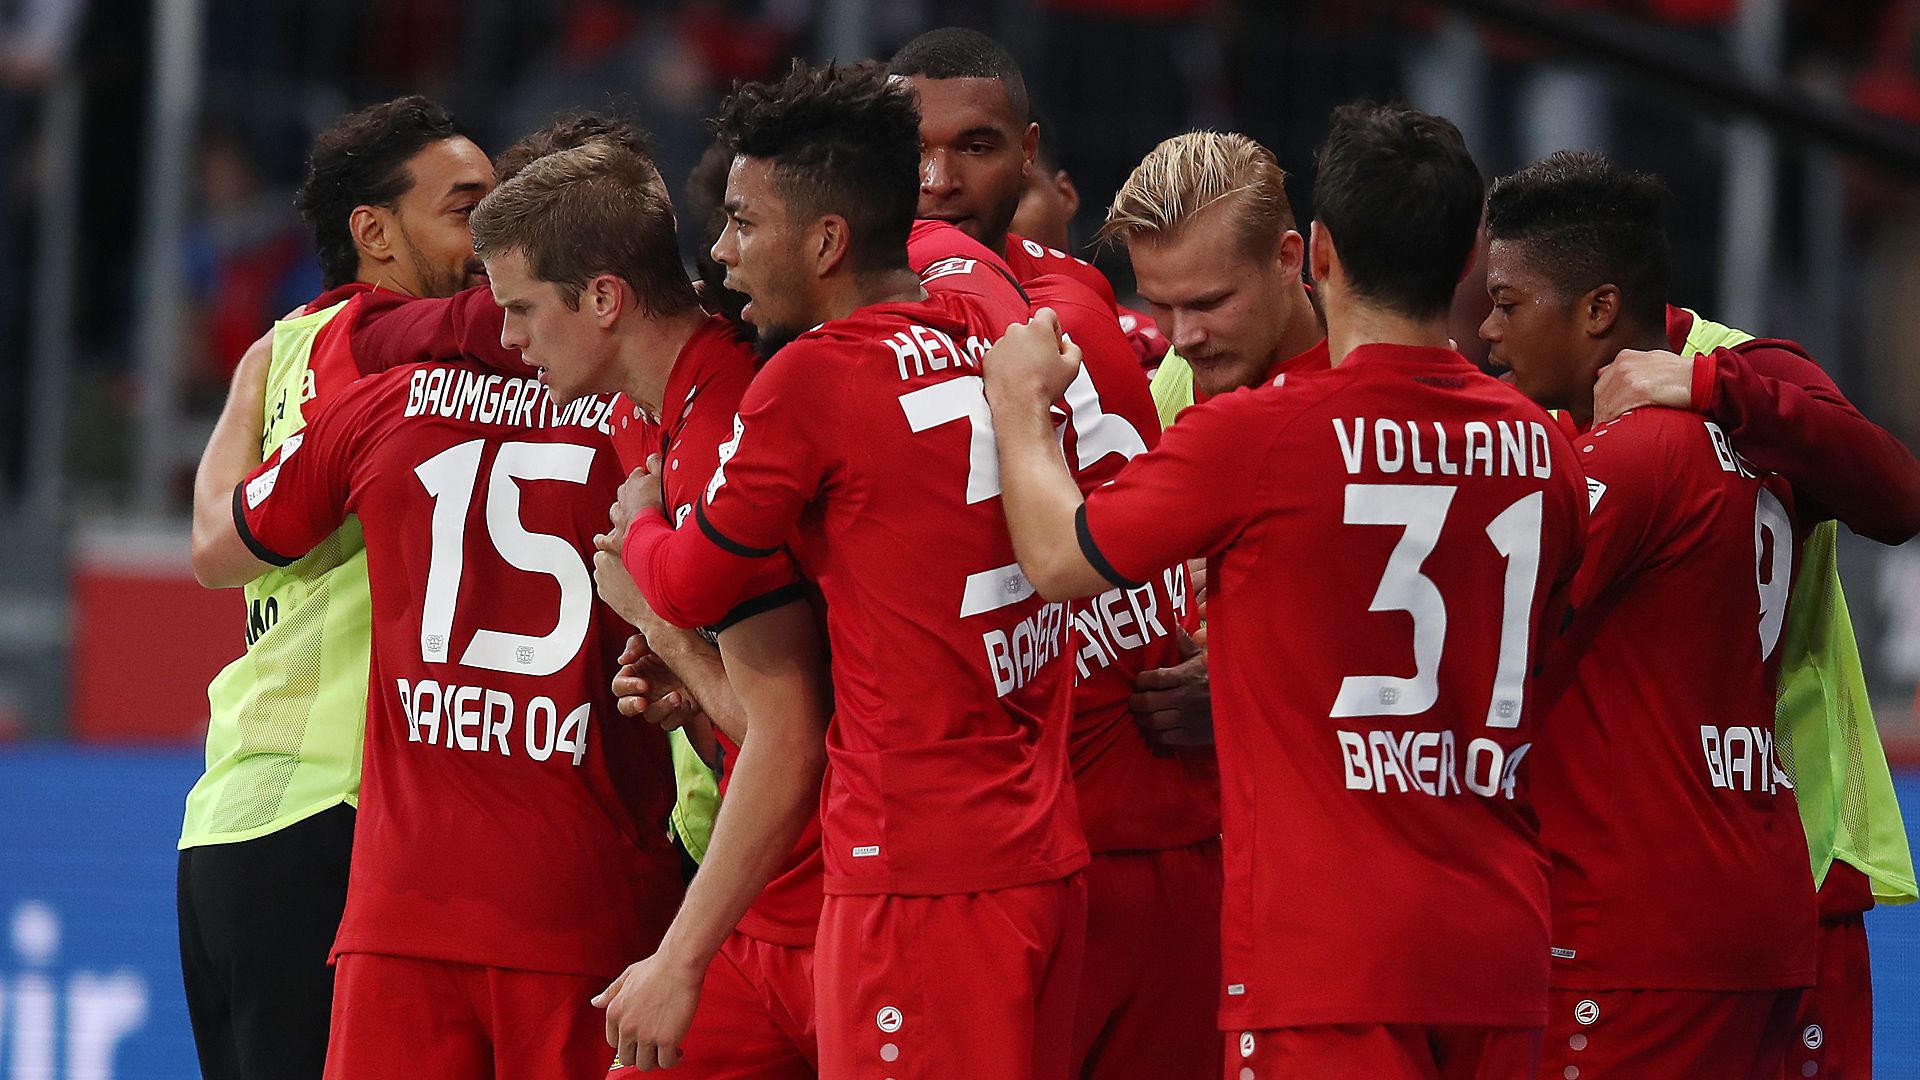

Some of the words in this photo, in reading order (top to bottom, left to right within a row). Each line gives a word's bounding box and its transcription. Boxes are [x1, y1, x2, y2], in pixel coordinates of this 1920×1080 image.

[1332, 417, 1551, 479] VOLLAND
[413, 439, 597, 676] 15
[1329, 484, 1544, 728] 31
[1754, 486, 1793, 663] 9
[1074, 581, 1168, 687] AYER
[525, 696, 591, 766] 04
[1336, 729, 1461, 797] BAYER
[1464, 737, 1533, 800] 04
[0, 898, 149, 1080] ir
